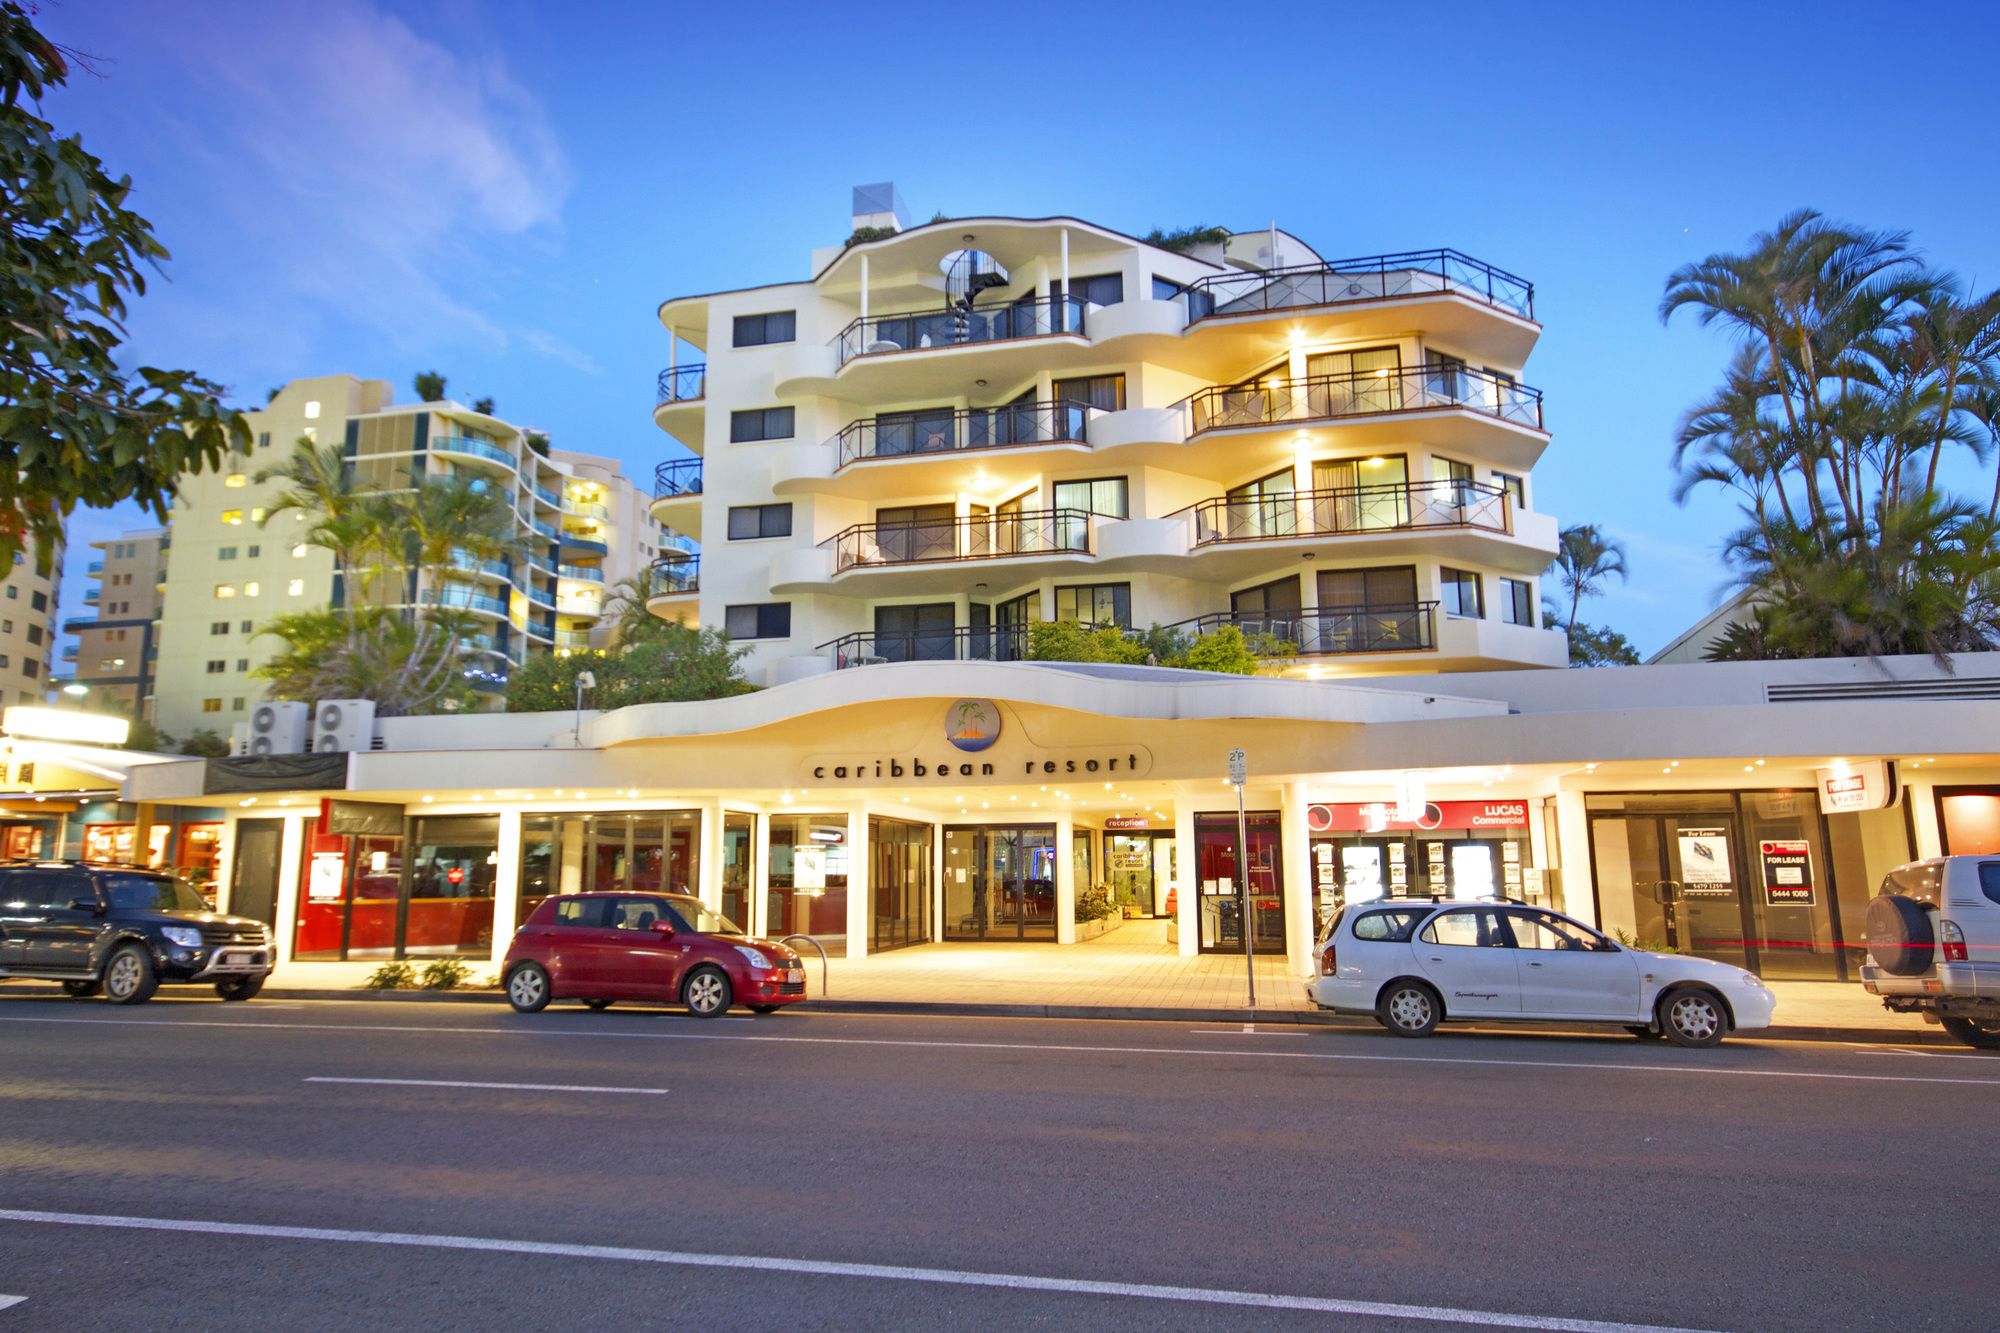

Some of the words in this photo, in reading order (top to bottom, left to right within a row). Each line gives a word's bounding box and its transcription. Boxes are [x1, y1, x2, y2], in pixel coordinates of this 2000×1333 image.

[1229, 752, 1245, 761] 2P
[813, 758, 994, 778] caribbean
[1026, 753, 1137, 774] resort
[1485, 805, 1524, 815] LUCAS
[1108, 819, 1145, 827] reception
[1472, 815, 1525, 825] Commercial
